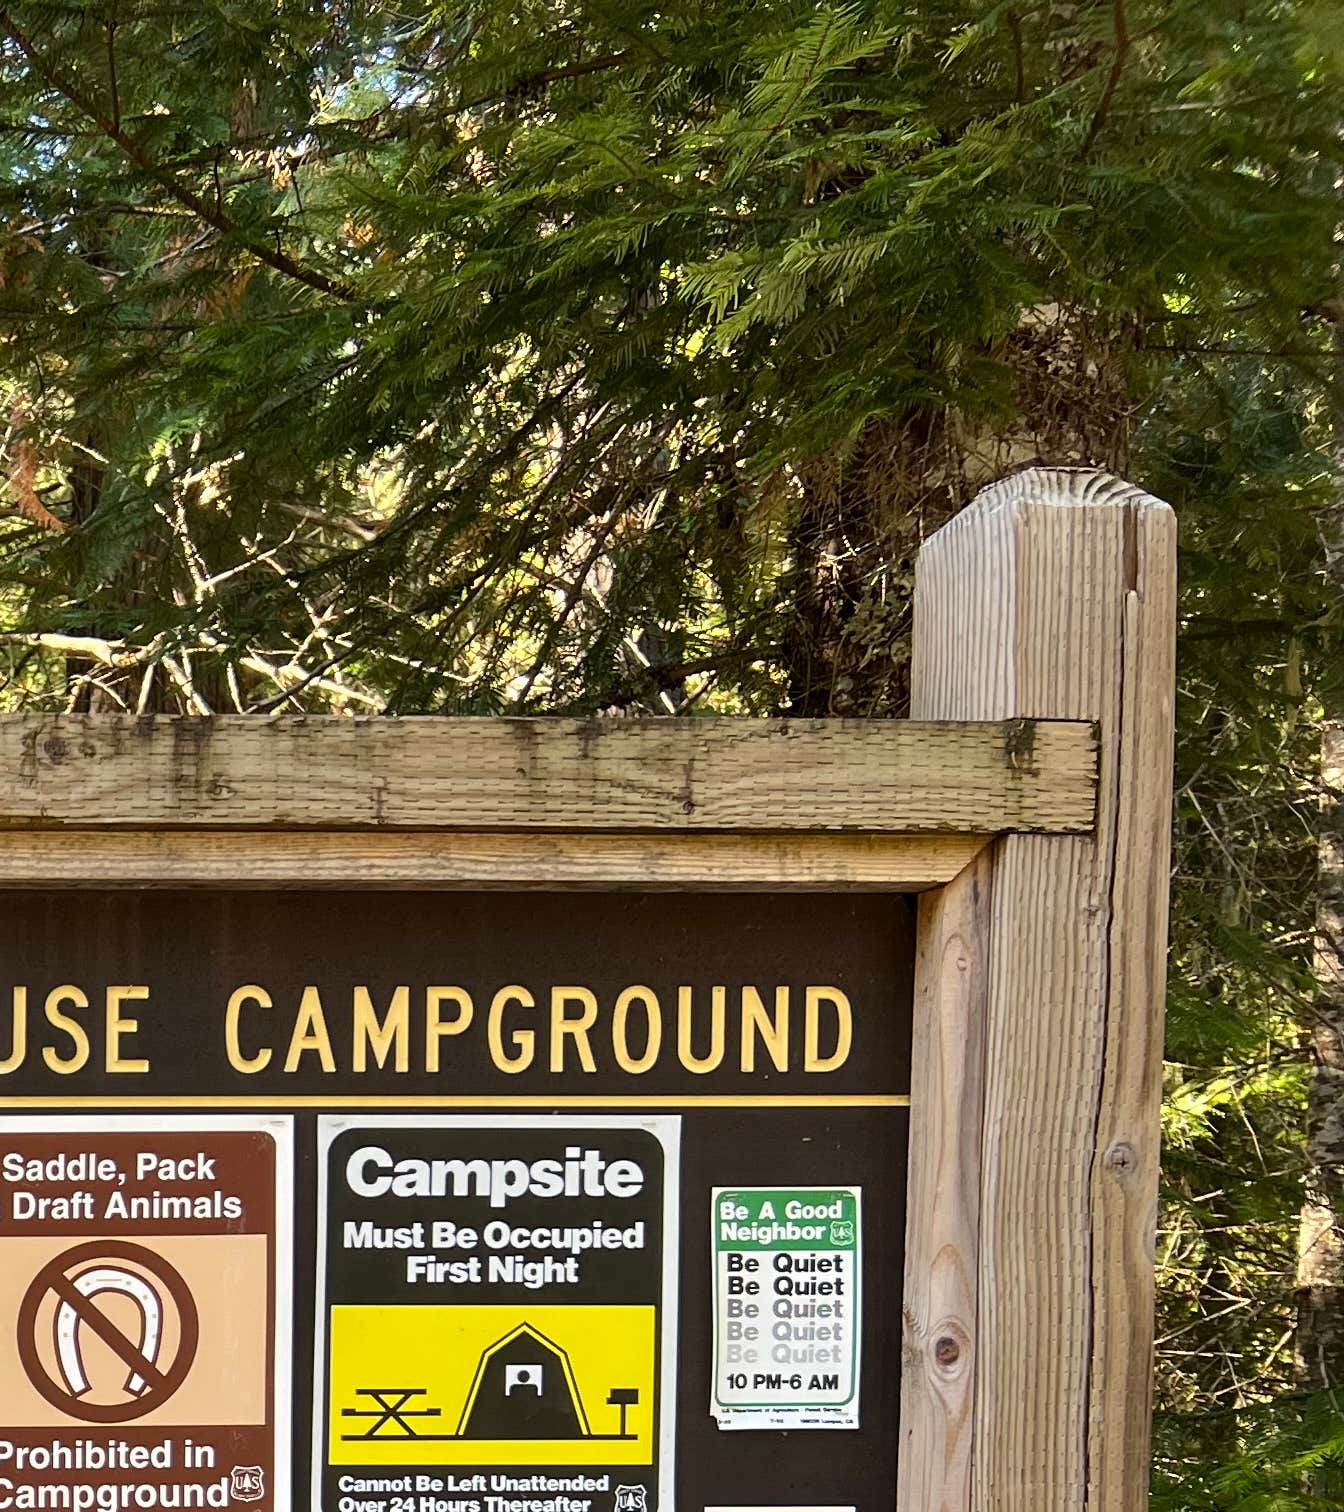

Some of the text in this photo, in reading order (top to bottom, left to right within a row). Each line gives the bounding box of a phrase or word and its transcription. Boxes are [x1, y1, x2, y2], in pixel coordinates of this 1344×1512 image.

[226, 985, 852, 1078] CAMPGROUND
[2, 1152, 216, 1186] Saddle, Pack
[346, 1147, 643, 1207] Campsite
[13, 1191, 95, 1220] Draft
[103, 1190, 242, 1219] Animals
[719, 1199, 843, 1221] Be A Good
[343, 1220, 645, 1255] Must Be Occupied
[720, 1221, 827, 1245] Neighbor
[406, 1255, 579, 1289] First Night
[726, 1373, 748, 1390] 10
[807, 1374, 839, 1391] AM
[184, 1439, 215, 1468] in
[338, 1474, 610, 1493] Cannot Be Left Unattended
[483, 1495, 592, 1512] Thereafter
